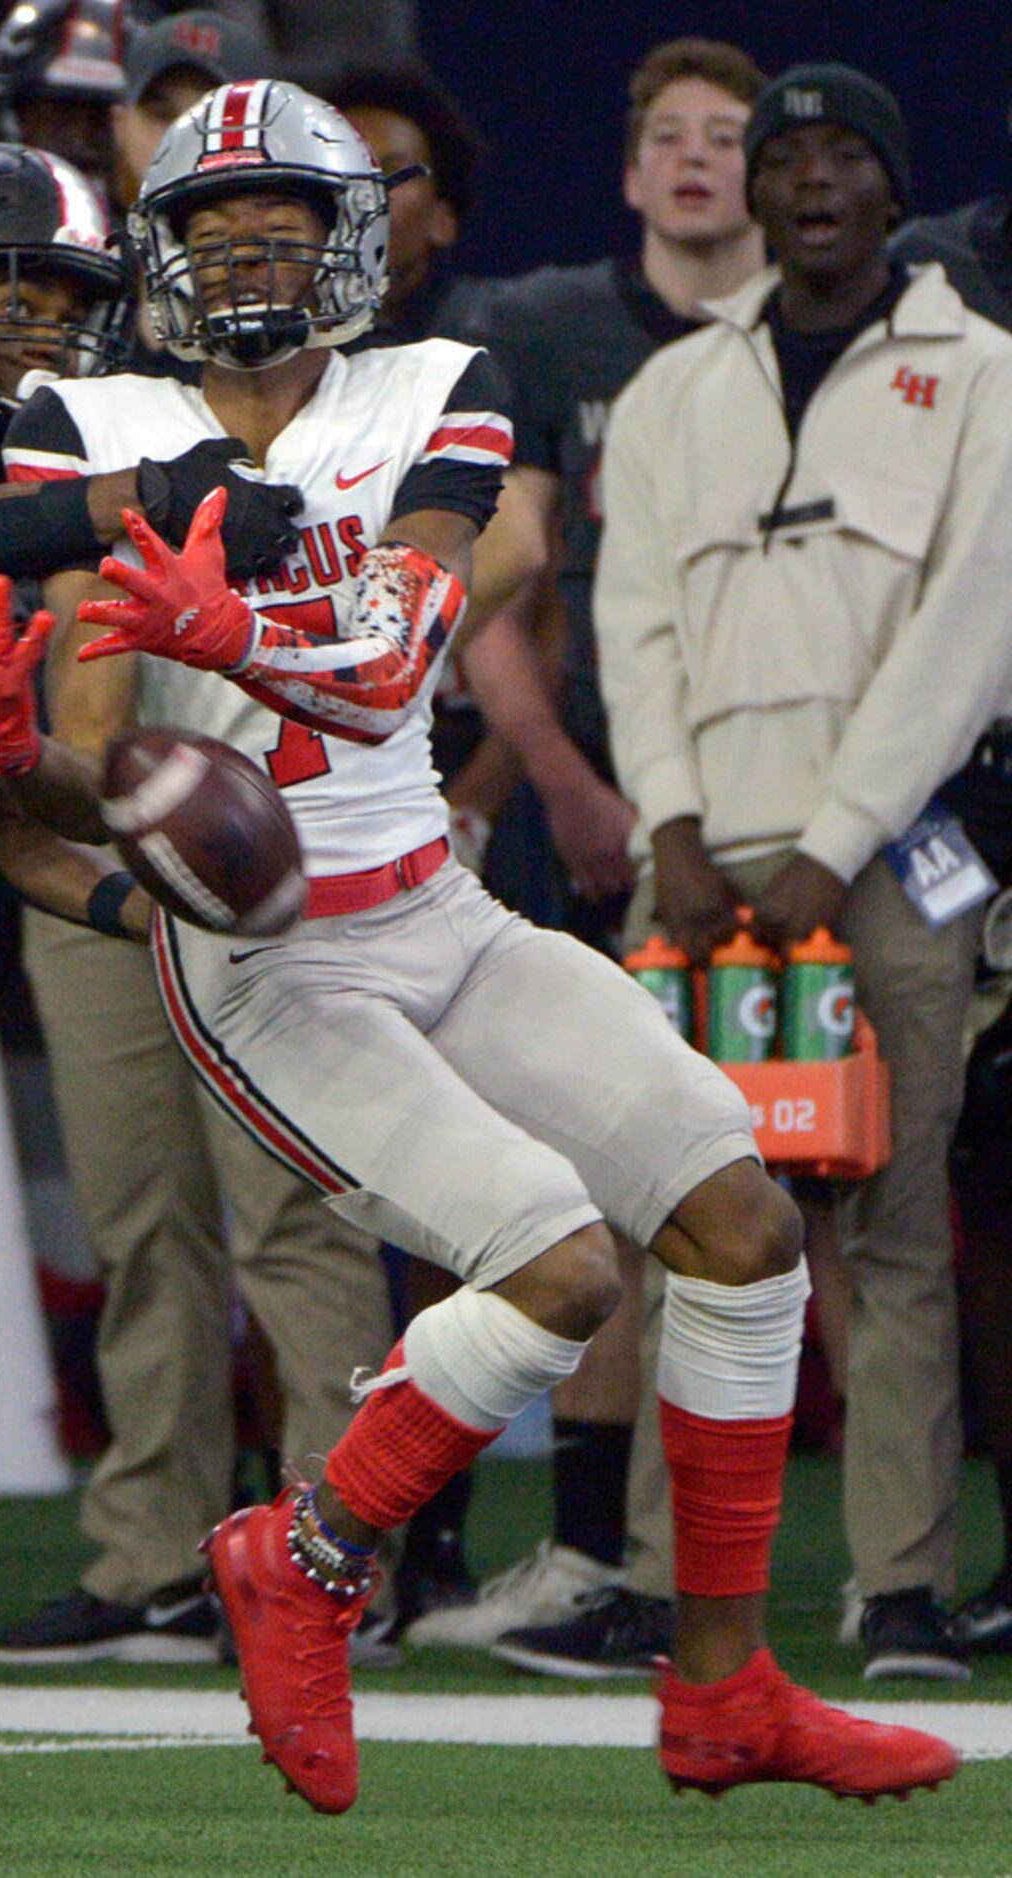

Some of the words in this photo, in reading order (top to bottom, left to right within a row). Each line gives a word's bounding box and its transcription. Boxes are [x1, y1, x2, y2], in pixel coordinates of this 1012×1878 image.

[890, 366, 939, 409] LH
[909, 835, 962, 888] AA
[773, 1098, 817, 1132] 02
